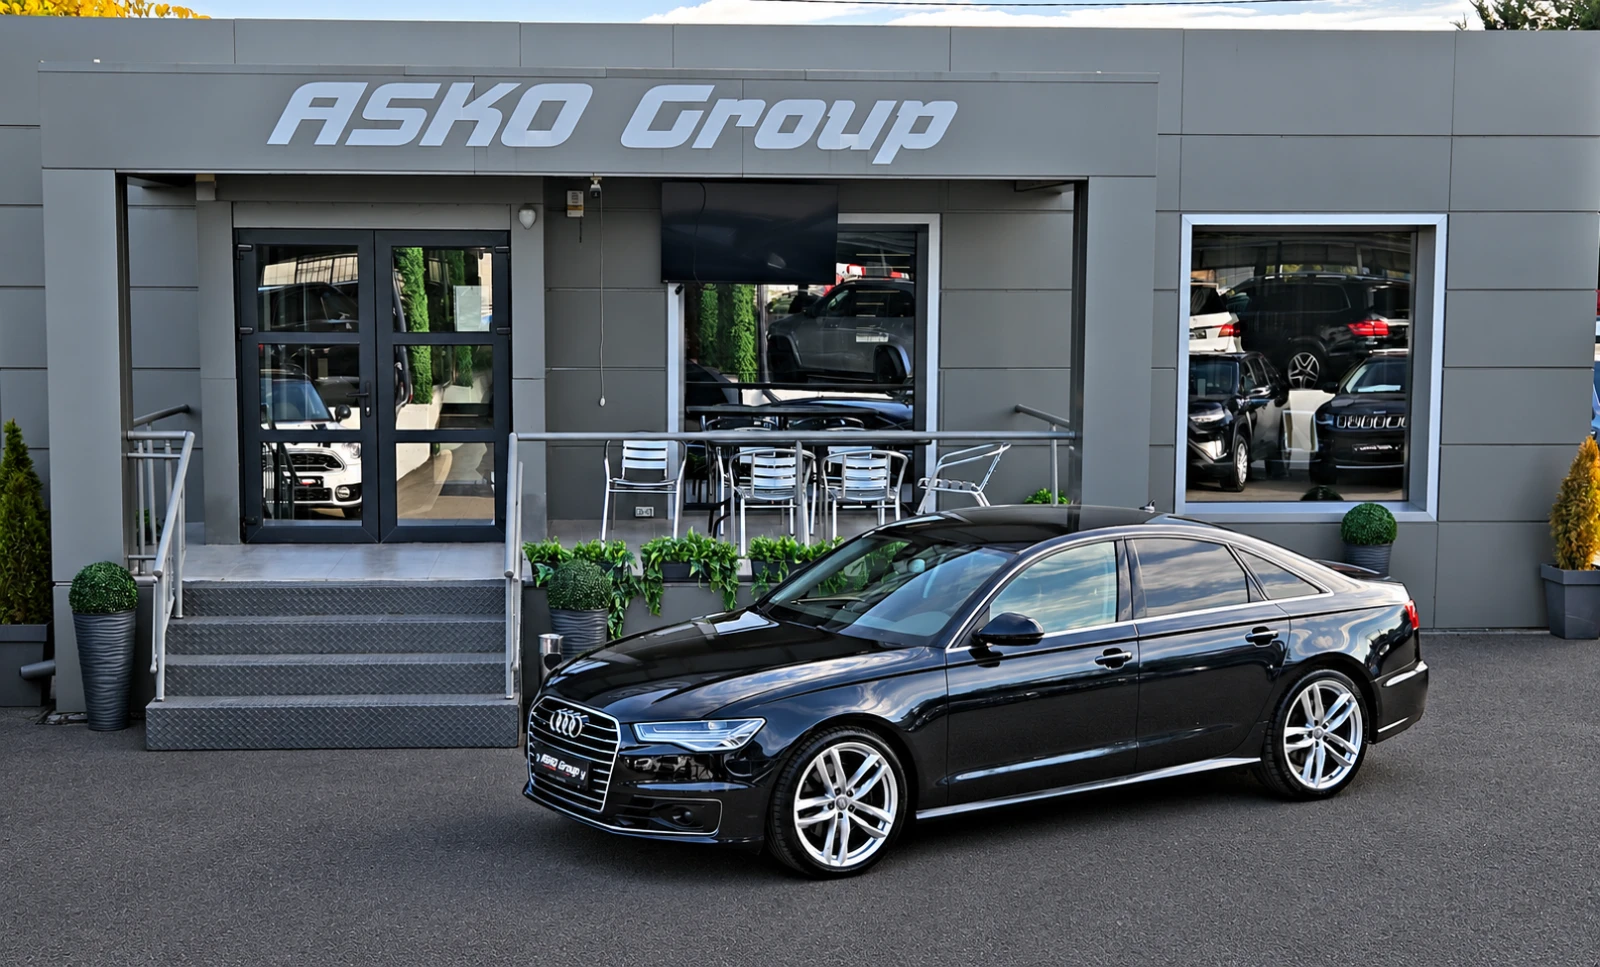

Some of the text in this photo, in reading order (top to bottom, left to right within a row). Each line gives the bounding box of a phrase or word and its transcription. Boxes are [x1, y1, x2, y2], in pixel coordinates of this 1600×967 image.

[267, 82, 957, 164] ASKO Group
[558, 760, 580, 778] Group
